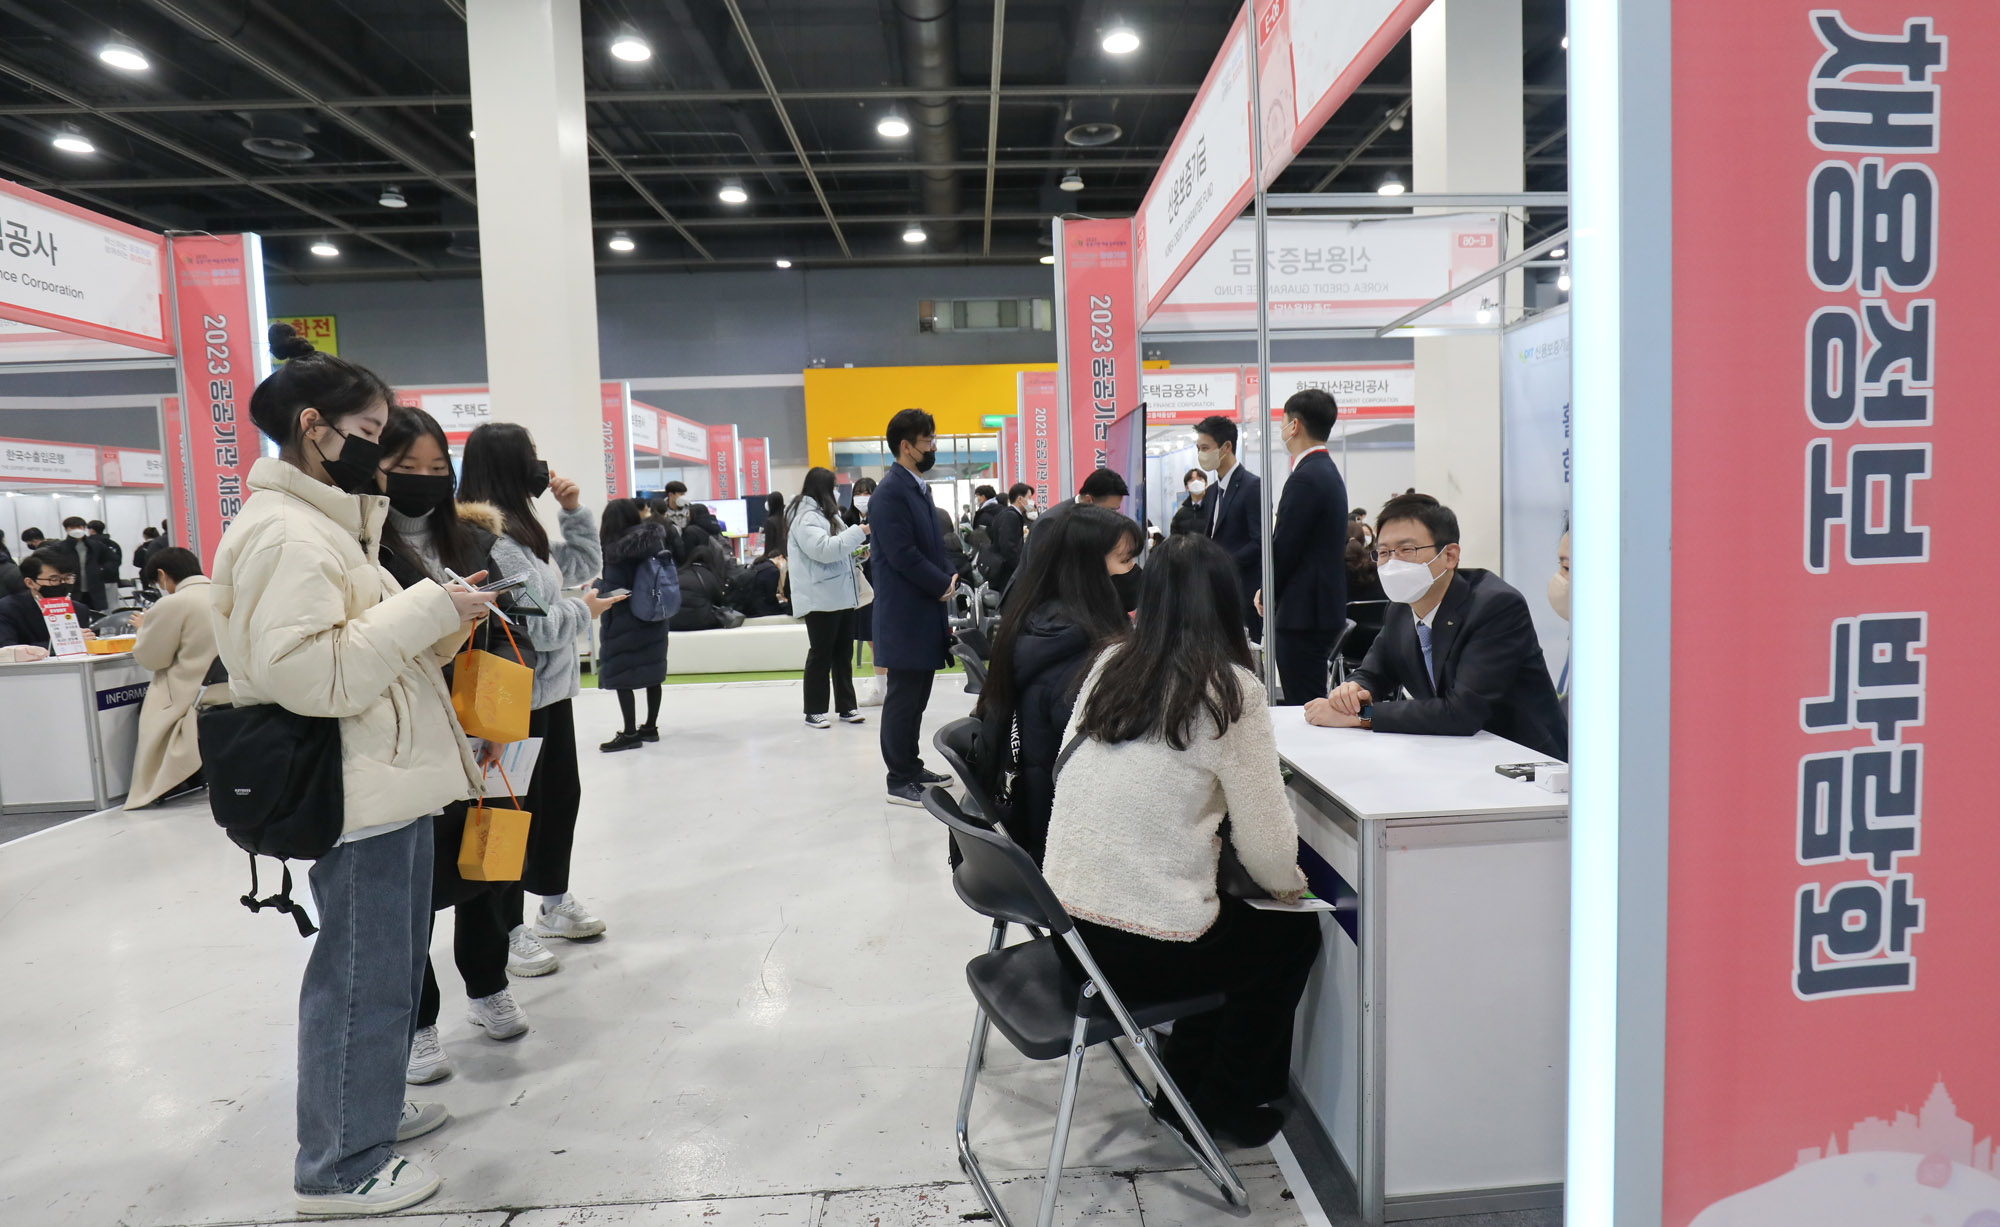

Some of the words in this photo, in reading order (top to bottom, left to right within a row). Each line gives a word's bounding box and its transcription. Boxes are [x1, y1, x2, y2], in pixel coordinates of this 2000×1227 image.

[1167, 133, 1207, 225] 신용보증기금
[0, 217, 58, 267] 공사
[21, 273, 85, 300] Corporation
[1803, 8, 1949, 574] 채용정보
[203, 312, 231, 376] 2023
[276, 317, 331, 338] 화전
[1090, 294, 1114, 353] 2023
[209, 379, 239, 468] 공공기관
[1034, 407, 1048, 437] 2023
[717, 450, 728, 473] 2023
[1035, 438, 1049, 481] 공공기관
[217, 474, 242, 534] 채용
[1791, 610, 1929, 1002] 박람회
